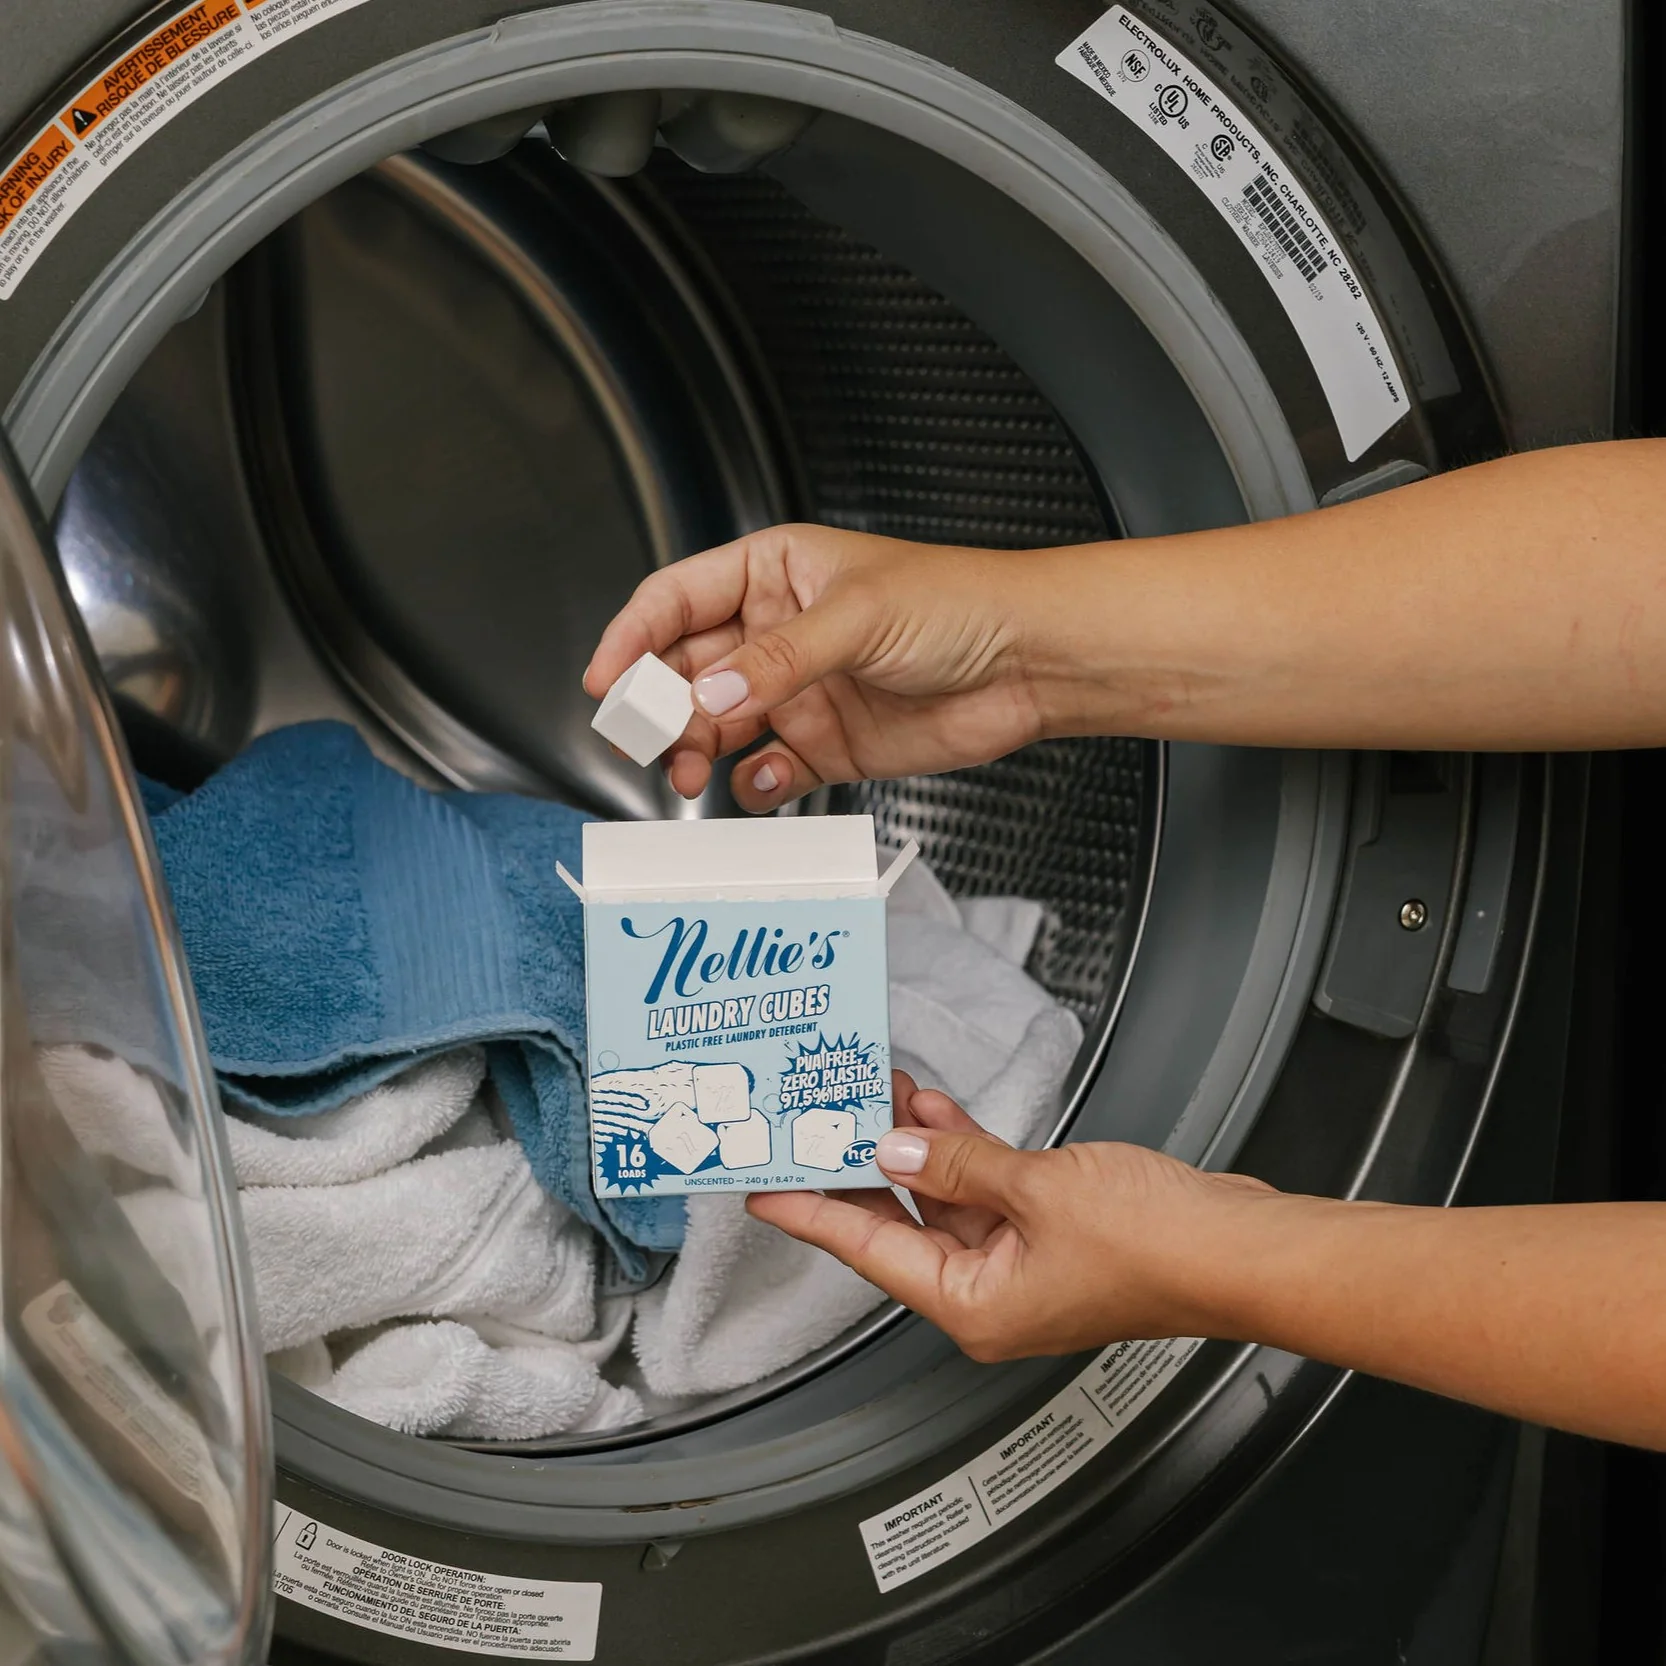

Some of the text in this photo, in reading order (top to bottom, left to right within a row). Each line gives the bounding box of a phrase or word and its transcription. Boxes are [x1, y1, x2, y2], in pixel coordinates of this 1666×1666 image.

[103, 5, 208, 92] AVERTISSEMENT
[144, 53, 168, 76] DE
[164, 4, 239, 60] BLESSURE
[1148, 102, 1168, 126] LISTED
[1154, 83, 1163, 92] C
[1178, 115, 1190, 130] US
[1119, 14, 1363, 301] ELECTROLUX HOME PRODUCTS, INC. CHARLOTTE, NC 28262
[10, 186, 26, 208] OF
[25, 140, 69, 190] INJURY
[1386, 382, 1400, 403] AMPS
[621, 917, 841, 1004] Nellie's
[647, 984, 831, 1040] LAUNDRY CUBES
[665, 1021, 818, 1052] PLASTIC FREE LAUNDRY DETERGENT
[781, 1062, 879, 1092] ZERO PLASTIC
[796, 1053, 823, 1073] PVA
[780, 1078, 884, 1109] 97.5% BETTER
[616, 1143, 647, 1168] 16
[618, 1168, 647, 1179] LOADS
[684, 1177, 735, 1186] UNSCENTED
[745, 1176, 762, 1185] 240
[762, 1178, 769, 1187] g
[775, 1175, 794, 1184] 8.47
[795, 1176, 806, 1184] oz
[999, 1412, 1056, 1460] IMPORTANT
[884, 1492, 943, 1531] IMPORTANT
[326, 1537, 343, 1550] Door
[350, 1548, 373, 1562] locked
[442, 1576, 459, 1585] NOT
[477, 1583, 494, 1591] door
[494, 1586, 511, 1595] open
[521, 1589, 545, 1598] closed
[381, 1551, 487, 1583] DOOR LOCK OPERATION:
[274, 1580, 294, 1594] 1705
[403, 1582, 416, 1593] DE
[417, 1586, 458, 1603] SERRURE
[459, 1596, 473, 1605] DE
[473, 1598, 506, 1610] PORTE:
[323, 1581, 522, 1635] FUNCIONAMIENTO DEL SEGURO DE LA PUERTA:
